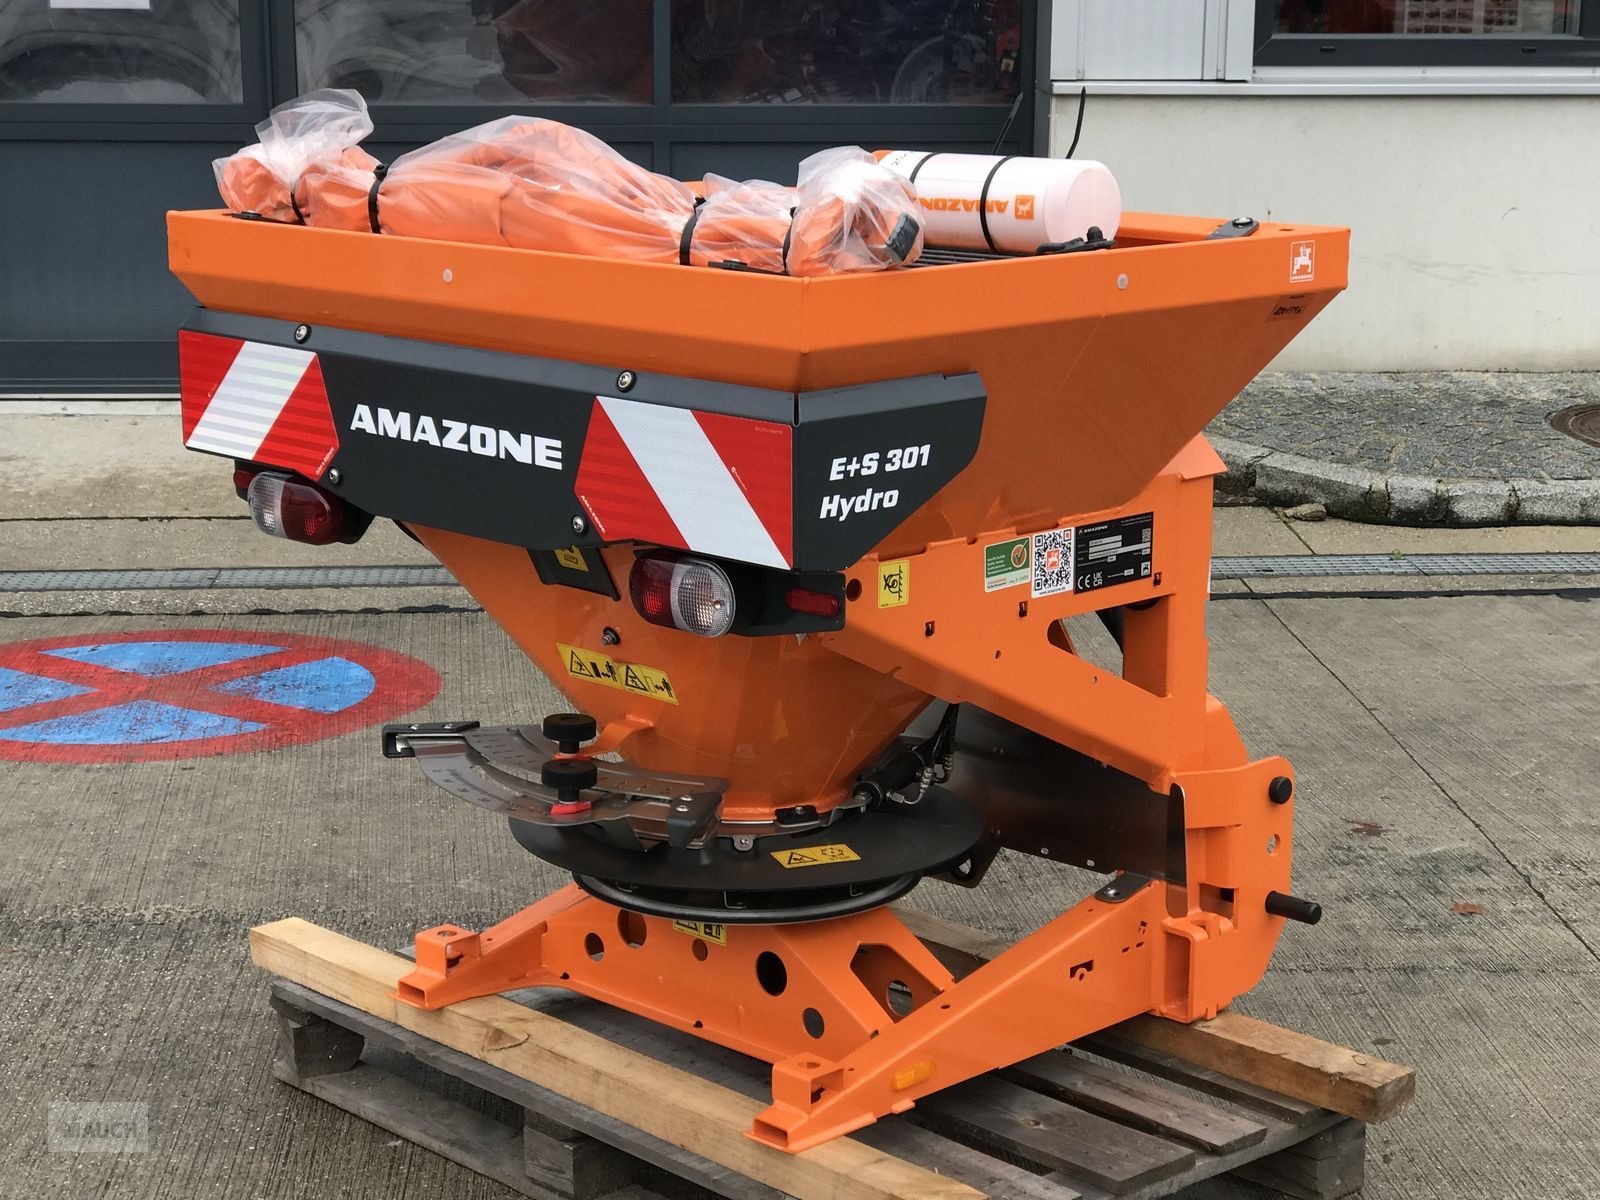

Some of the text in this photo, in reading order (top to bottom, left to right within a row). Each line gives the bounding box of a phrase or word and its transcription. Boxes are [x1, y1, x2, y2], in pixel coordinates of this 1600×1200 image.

[915, 197, 1009, 214] AMAZON
[350, 403, 563, 470] AMAZONE
[829, 444, 931, 481] E+S 301
[580, 495, 606, 534] AMAZONE
[819, 488, 899, 522] Hydro
